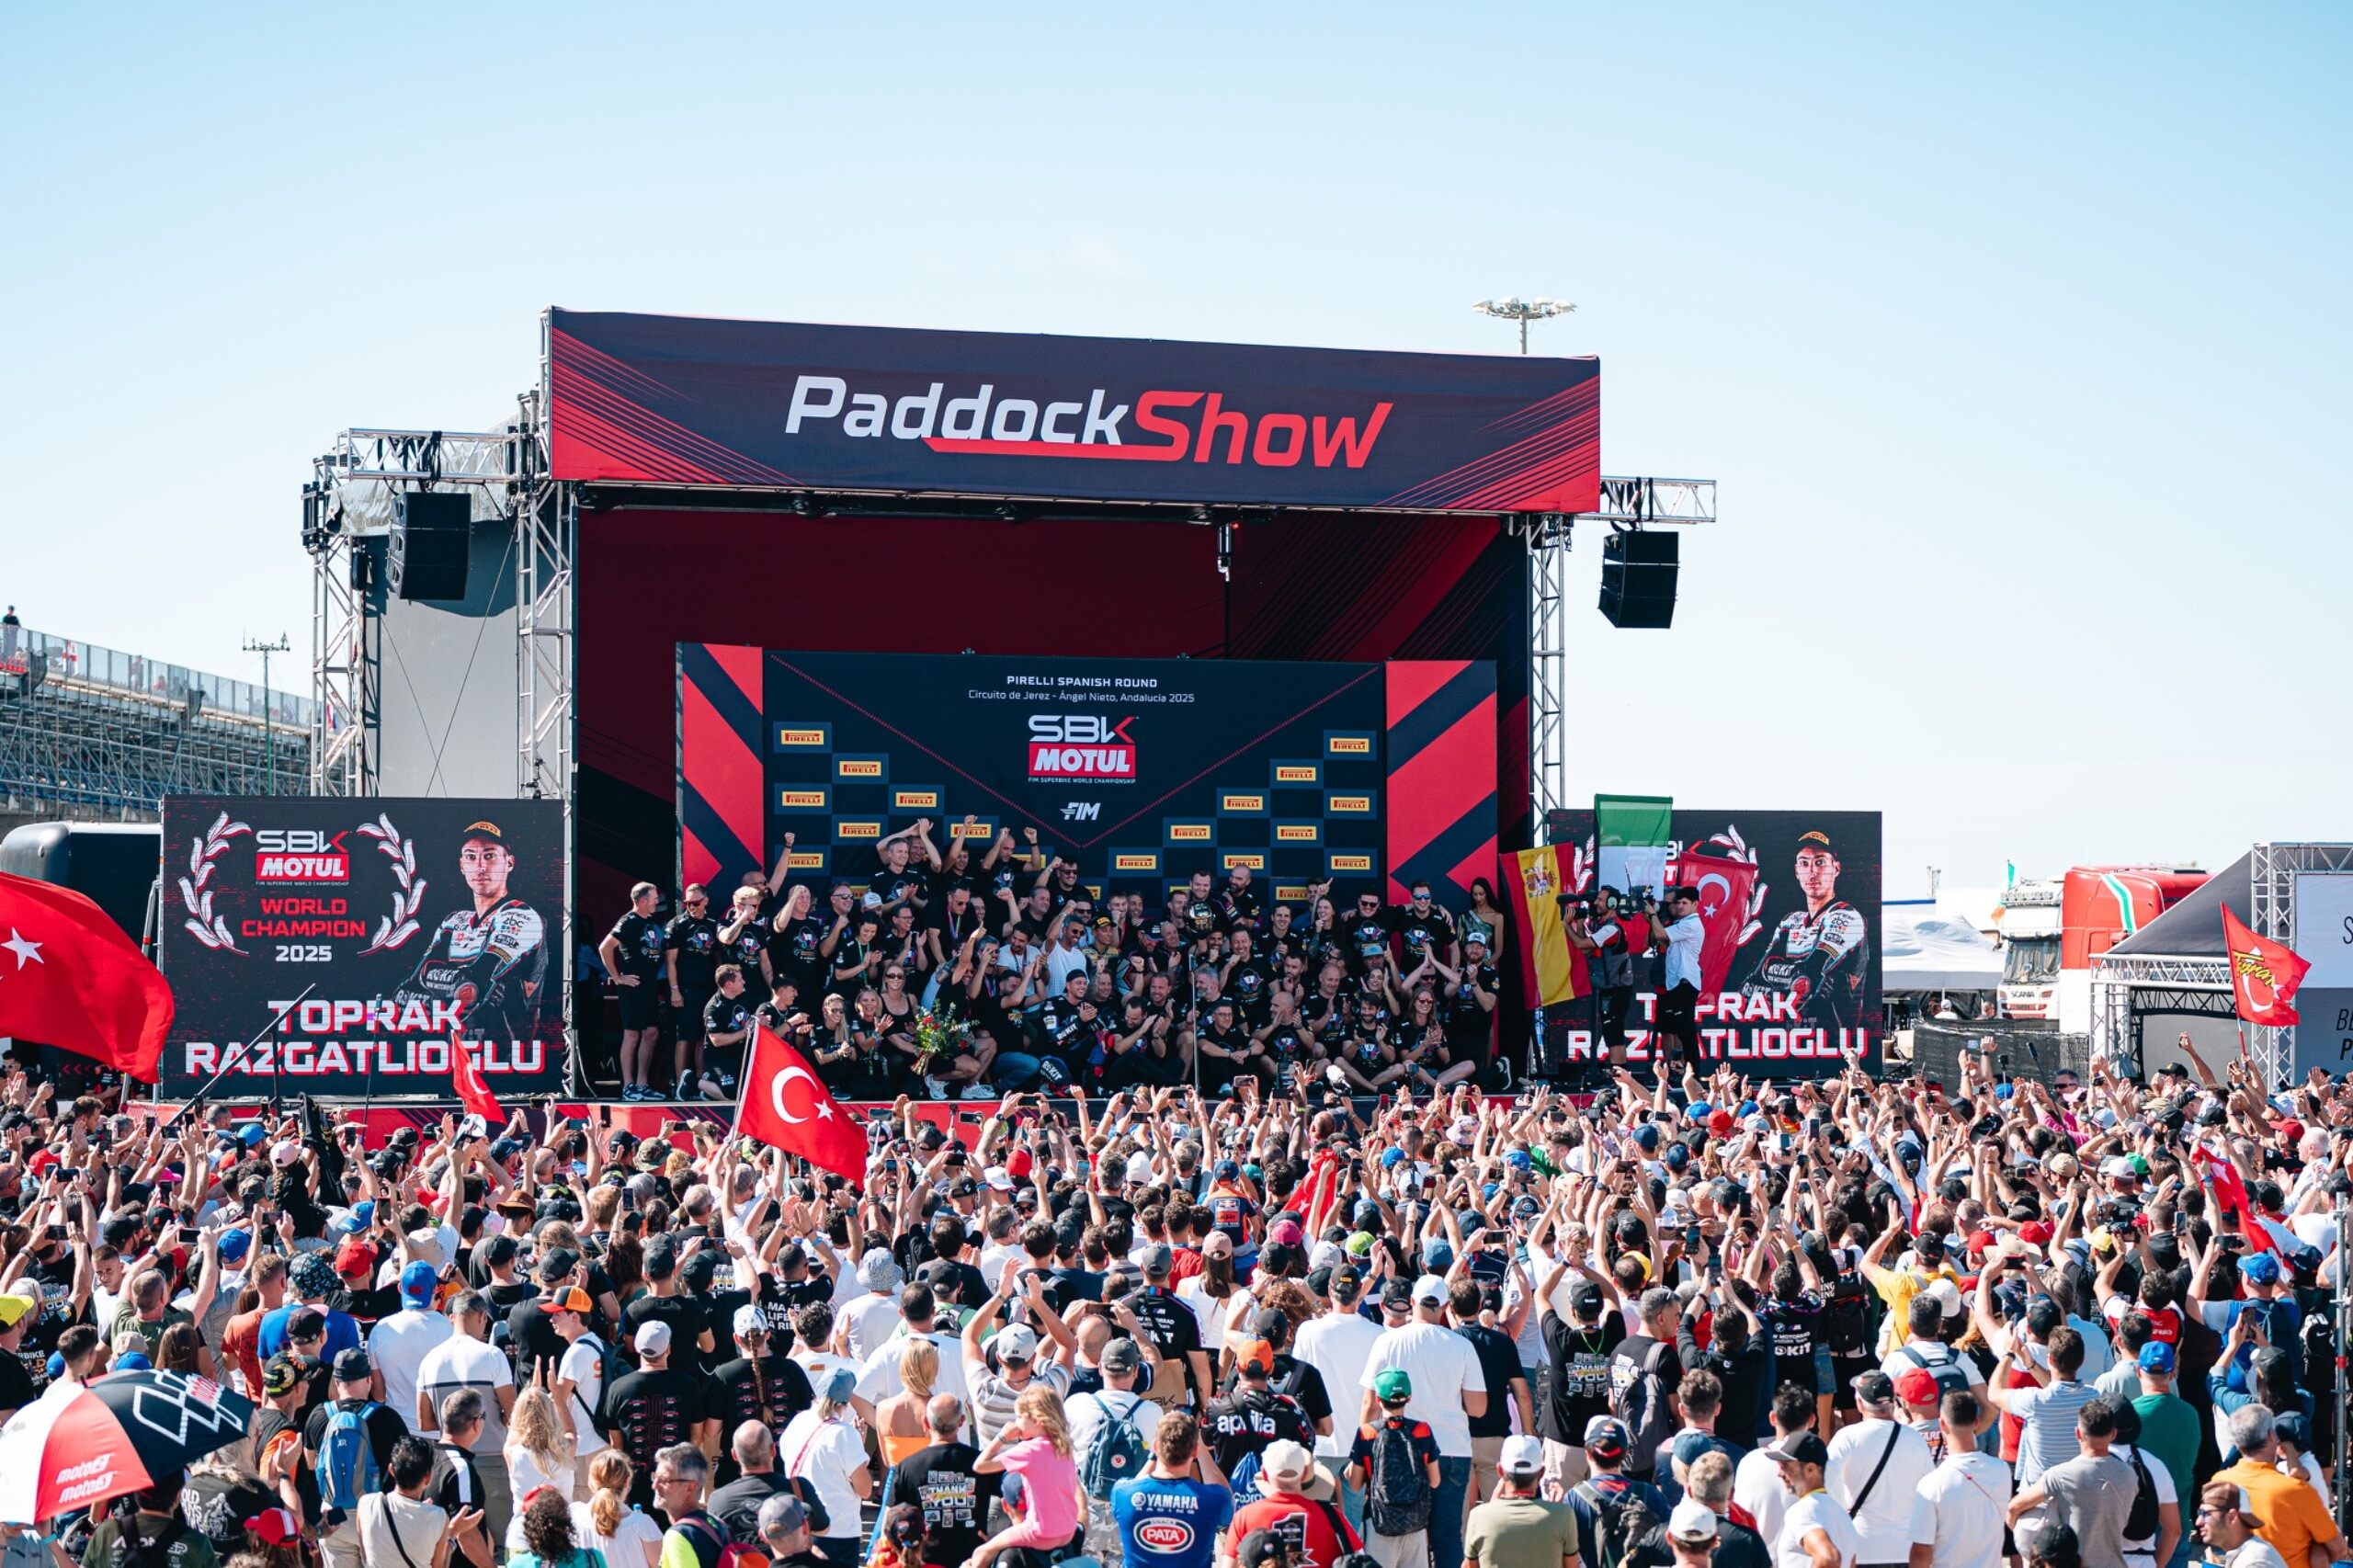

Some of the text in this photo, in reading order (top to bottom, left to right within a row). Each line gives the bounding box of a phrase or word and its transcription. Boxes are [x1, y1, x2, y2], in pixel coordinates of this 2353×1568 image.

[1006, 676, 1157, 687] PIRELLI SPANISH ROUND
[969, 689, 1006, 699] Circuito
[1011, 690, 1021, 699] de
[1023, 691, 1051, 700] Jerez
[1059, 689, 1087, 703] Ángel
[1089, 692, 1119, 702] Nieto,
[1168, 693, 1195, 703] 2025
[1028, 715, 1135, 744] SBK
[784, 733, 820, 742] PIRELLI
[1333, 741, 1366, 750] PIRELLI
[1034, 748, 1131, 772] MOTUL
[843, 764, 878, 773] PIRELLI
[1279, 769, 1313, 778] PIRELLI
[785, 794, 821, 803] PIRELLI
[899, 795, 933, 804] PIRELLI
[1227, 799, 1259, 808] PIRELLI
[1333, 800, 1366, 809] PIRELLI
[1060, 802, 1101, 821] FIM
[842, 825, 877, 835] PIRELLI
[953, 826, 988, 835] PRELLI
[1174, 828, 1207, 836] PIRELLI
[1280, 828, 1313, 837] PIRELLI
[256, 830, 348, 854] SBK
[789, 856, 820, 865] IRELLI
[1119, 858, 1153, 867] PIRELLI
[1335, 858, 1367, 868] PIRELLI
[260, 858, 346, 877] MOTUL
[260, 898, 348, 916] WORLD
[241, 920, 366, 938] CHAMPION
[276, 945, 333, 962] 2025
[1635, 991, 1799, 1020] TPRAK
[267, 999, 464, 1032] TOPRAK
[1567, 1028, 1866, 1059] RZTLIOGLU
[768, 1302, 801, 1312] MAE
[1774, 1342, 1811, 1356] OKiT
[1146, 1494, 1199, 1510] YAMAHA
[1146, 1528, 1180, 1542] PATA
